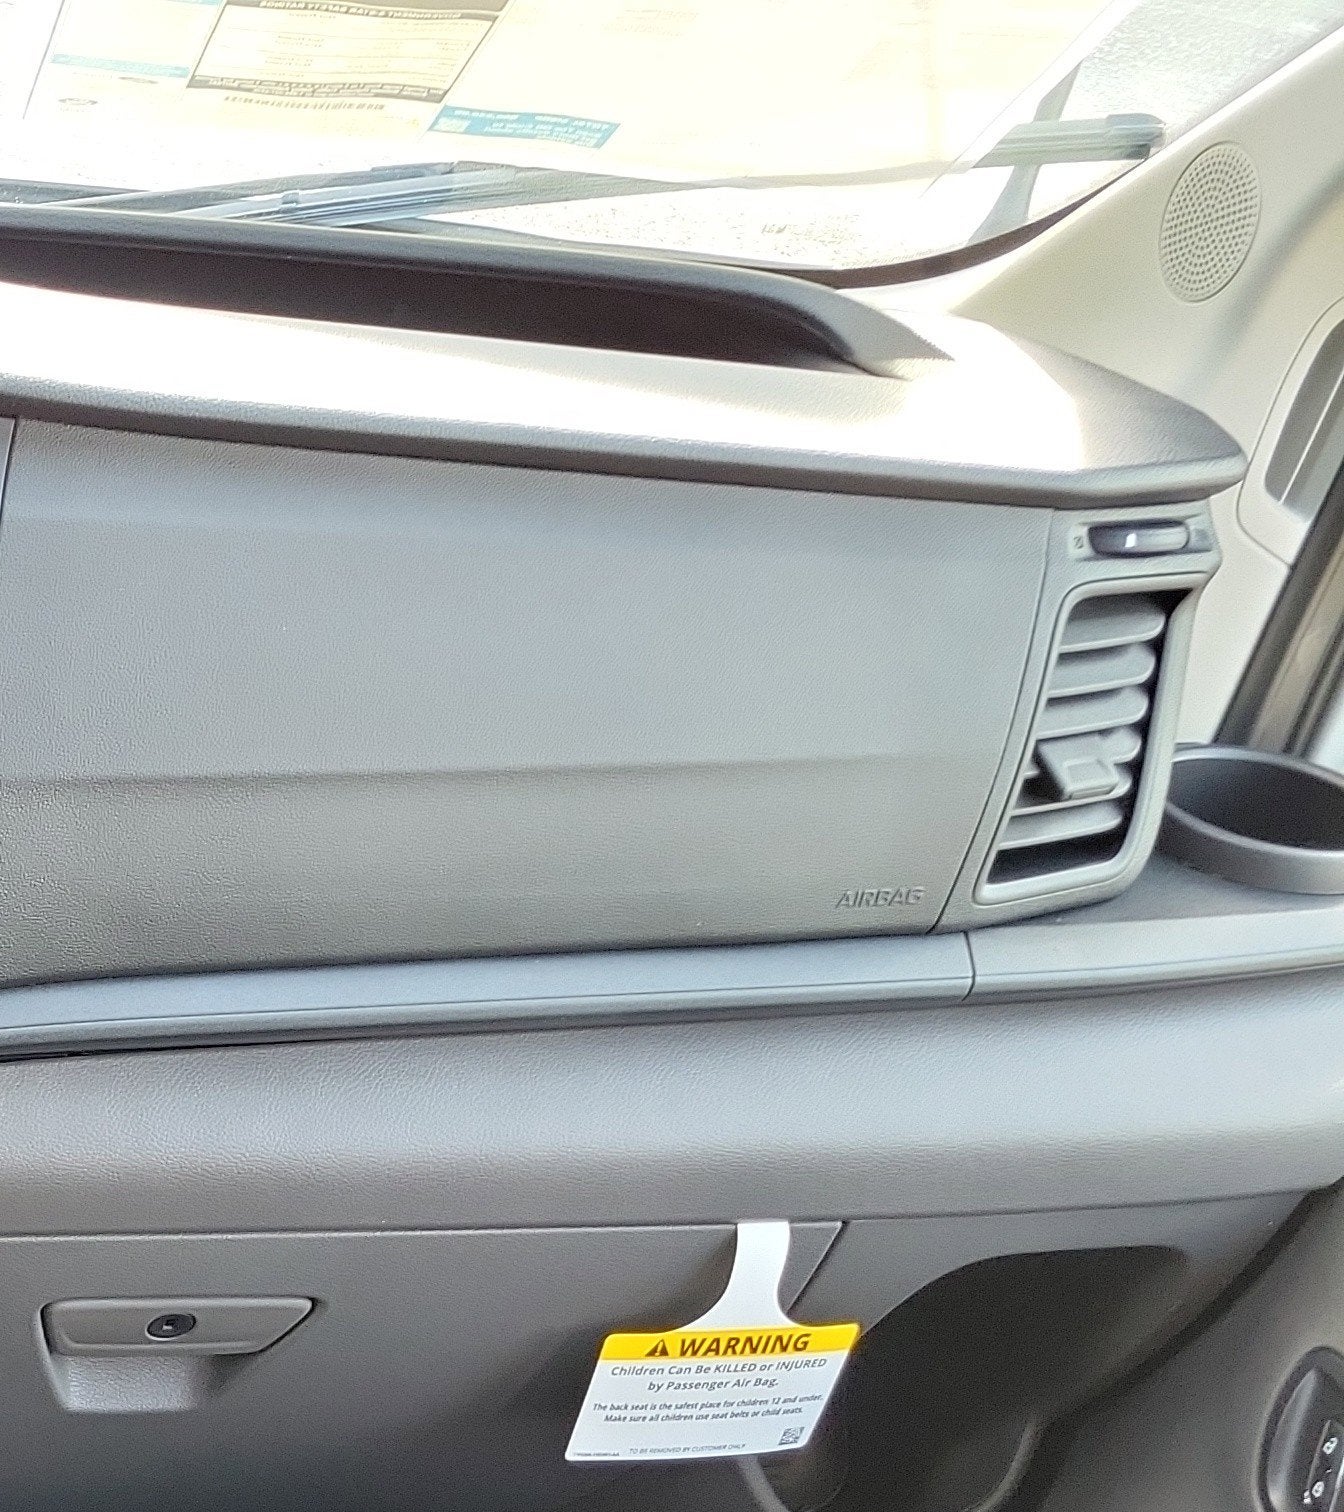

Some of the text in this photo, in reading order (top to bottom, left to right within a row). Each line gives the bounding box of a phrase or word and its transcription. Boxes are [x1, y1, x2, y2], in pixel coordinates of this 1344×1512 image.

[834, 886, 926, 909] AIRBAG
[679, 1333, 812, 1357] WARNING
[611, 1358, 827, 1376] Children Can Be KILLED or INJURED
[648, 1378, 779, 1393] by Passenger Air Bag.
[593, 1403, 608, 1411] The
[609, 1403, 629, 1411] back
[630, 1403, 649, 1411] seat
[650, 1403, 657, 1411] is
[674, 1402, 699, 1410] safest
[699, 1401, 722, 1411] place
[723, 1400, 736, 1408] for
[737, 1399, 769, 1407] children
[781, 1396, 798, 1404] and
[604, 1414, 627, 1422] Make
[648, 1414, 660, 1422] all
[661, 1413, 693, 1421] children
[711, 1411, 728, 1420] seat
[729, 1410, 750, 1419] belts
[761, 1408, 782, 1416] child
